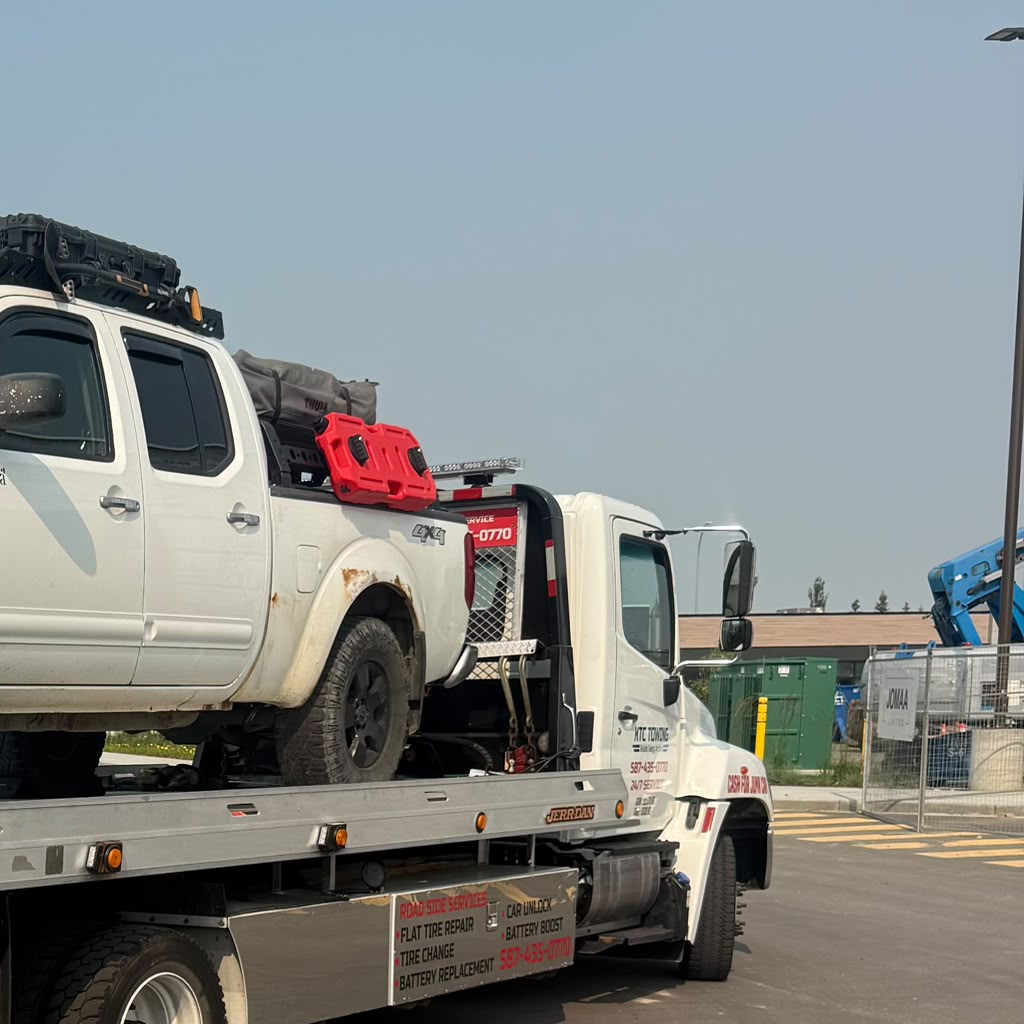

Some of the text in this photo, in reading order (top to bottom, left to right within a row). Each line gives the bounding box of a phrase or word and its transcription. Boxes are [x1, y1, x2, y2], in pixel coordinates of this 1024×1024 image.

[466, 515, 495, 524] ERVICE
[468, 527, 512, 542] -0770
[400, 890, 488, 920] ROAD SIDE SERVICES
[506, 898, 552, 919] CAR UNLOCK
[400, 916, 474, 943] FLAT TIRE REPAIR
[505, 916, 564, 941] BATTERY BOOST
[400, 942, 455, 967] TIRE CHANGE
[399, 957, 494, 991] BATTERY REPLACEMENT
